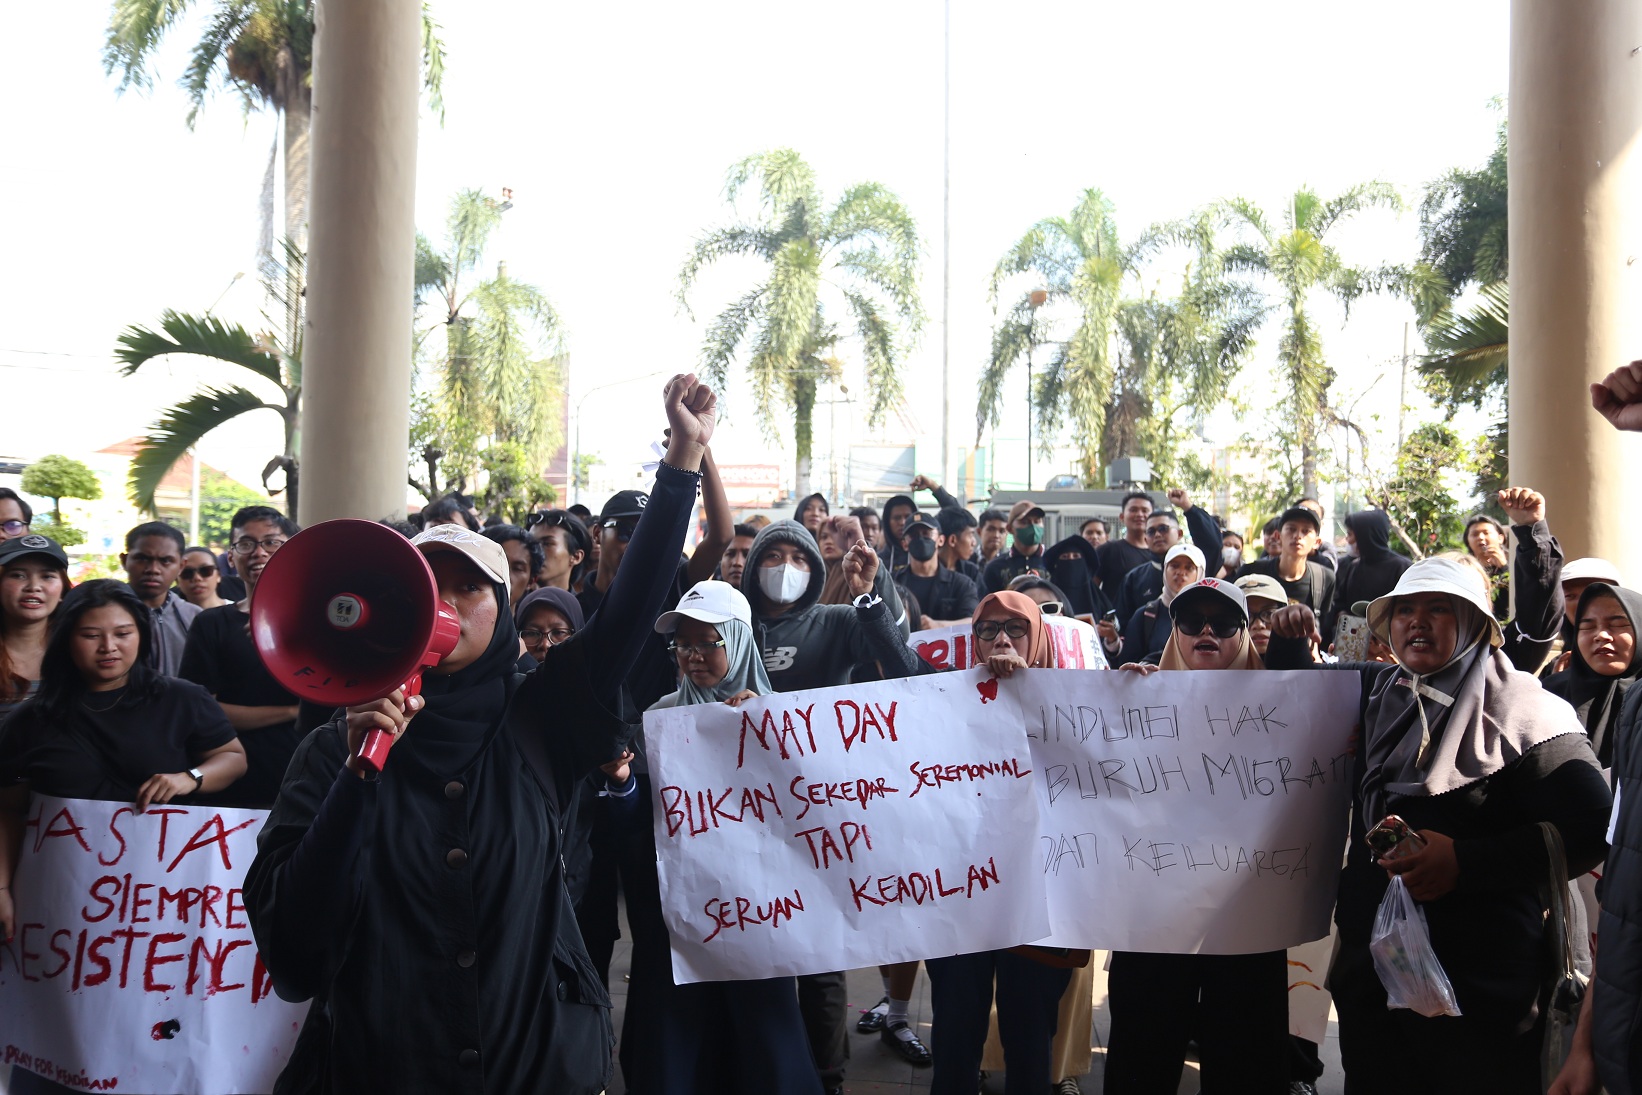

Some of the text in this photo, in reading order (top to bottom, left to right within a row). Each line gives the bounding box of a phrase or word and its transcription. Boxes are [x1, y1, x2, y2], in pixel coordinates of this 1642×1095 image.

[736, 699, 898, 770] MAY DAY
[1205, 703, 1288, 738] HAK
[659, 757, 1033, 838] BUKAN SEKEDAR SEREMONIAL
[1044, 752, 1349, 807] BURUH MIGRAN
[794, 821, 872, 869] TAPI
[1122, 835, 1312, 881] KELUARGA
[82, 873, 247, 930] SIEMPRE
[703, 856, 1001, 944] SERUAN KEADILAN
[34, 1057, 54, 1077] FOR
